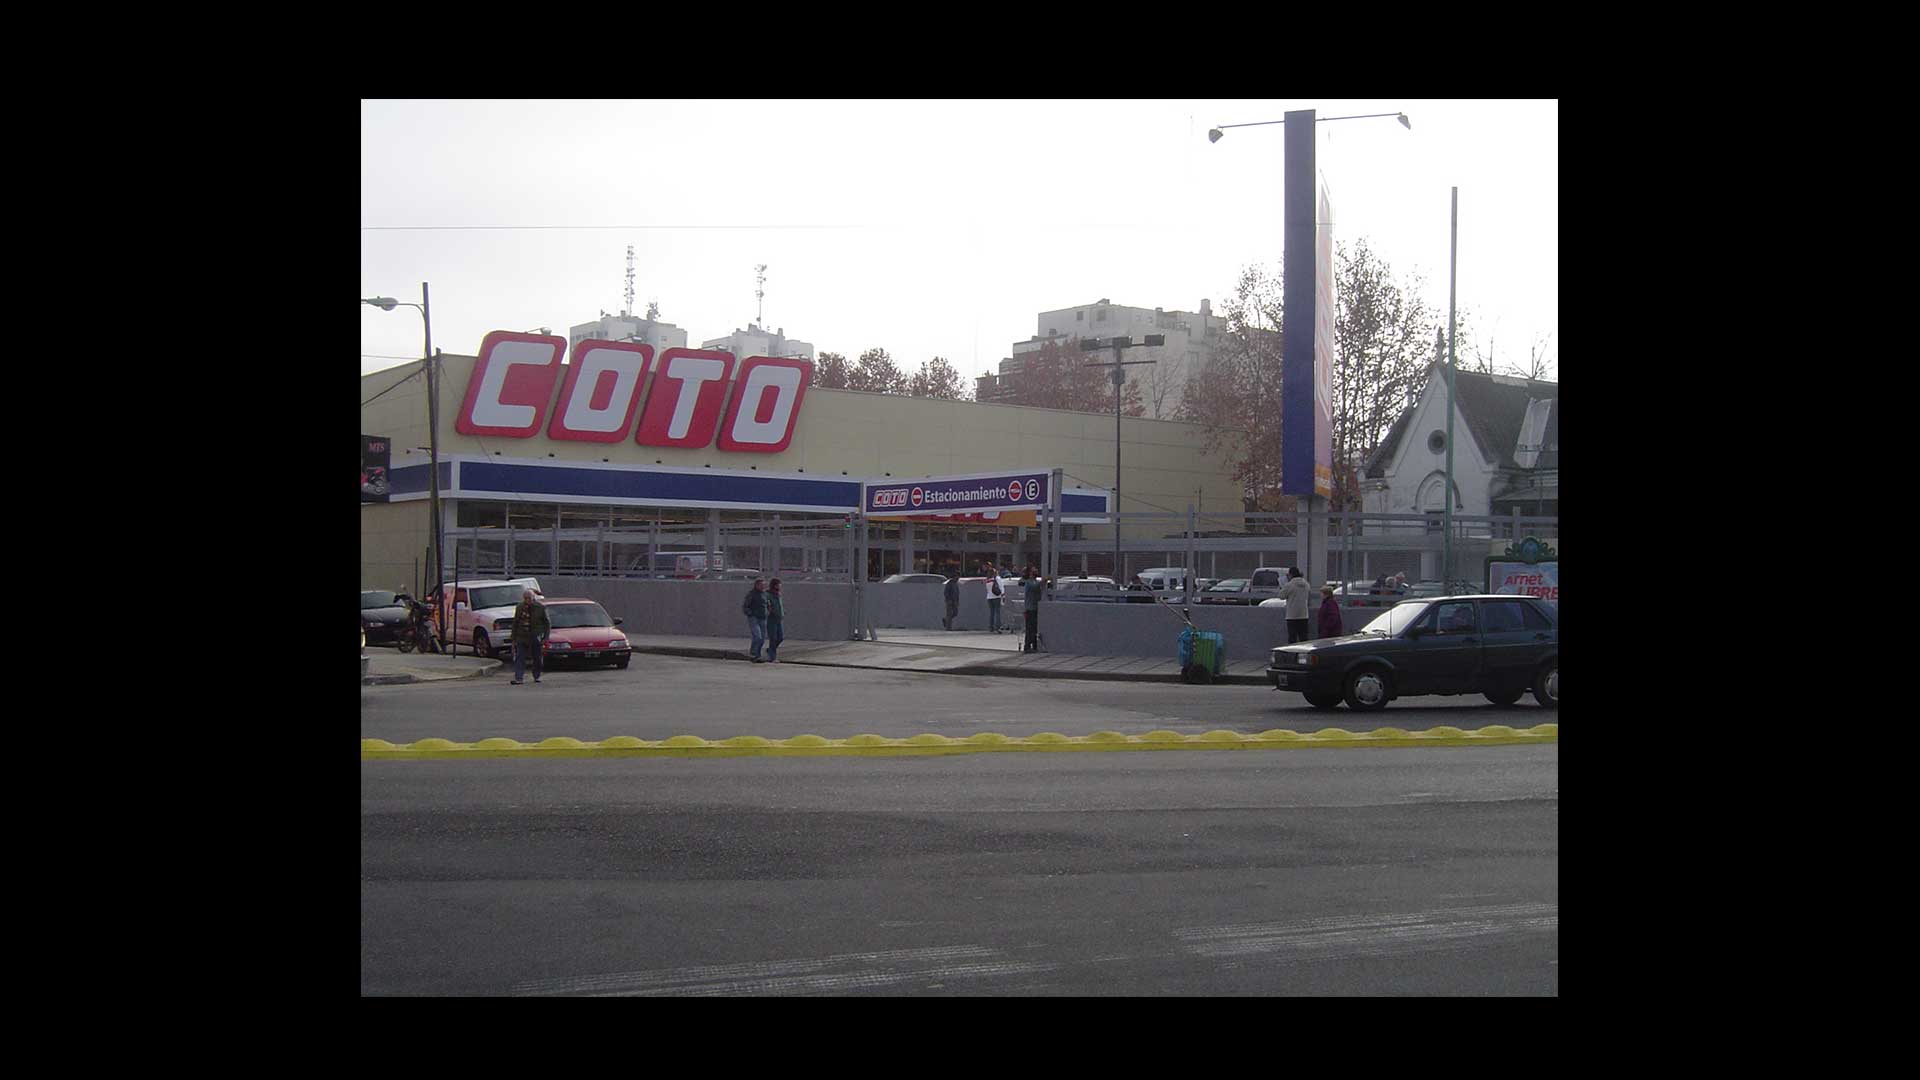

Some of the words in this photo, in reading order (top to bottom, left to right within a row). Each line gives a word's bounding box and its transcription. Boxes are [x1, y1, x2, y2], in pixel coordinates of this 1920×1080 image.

[467, 338, 805, 446] COTO
[873, 489, 909, 507] COTO
[924, 485, 1007, 504] Estacionamiento
